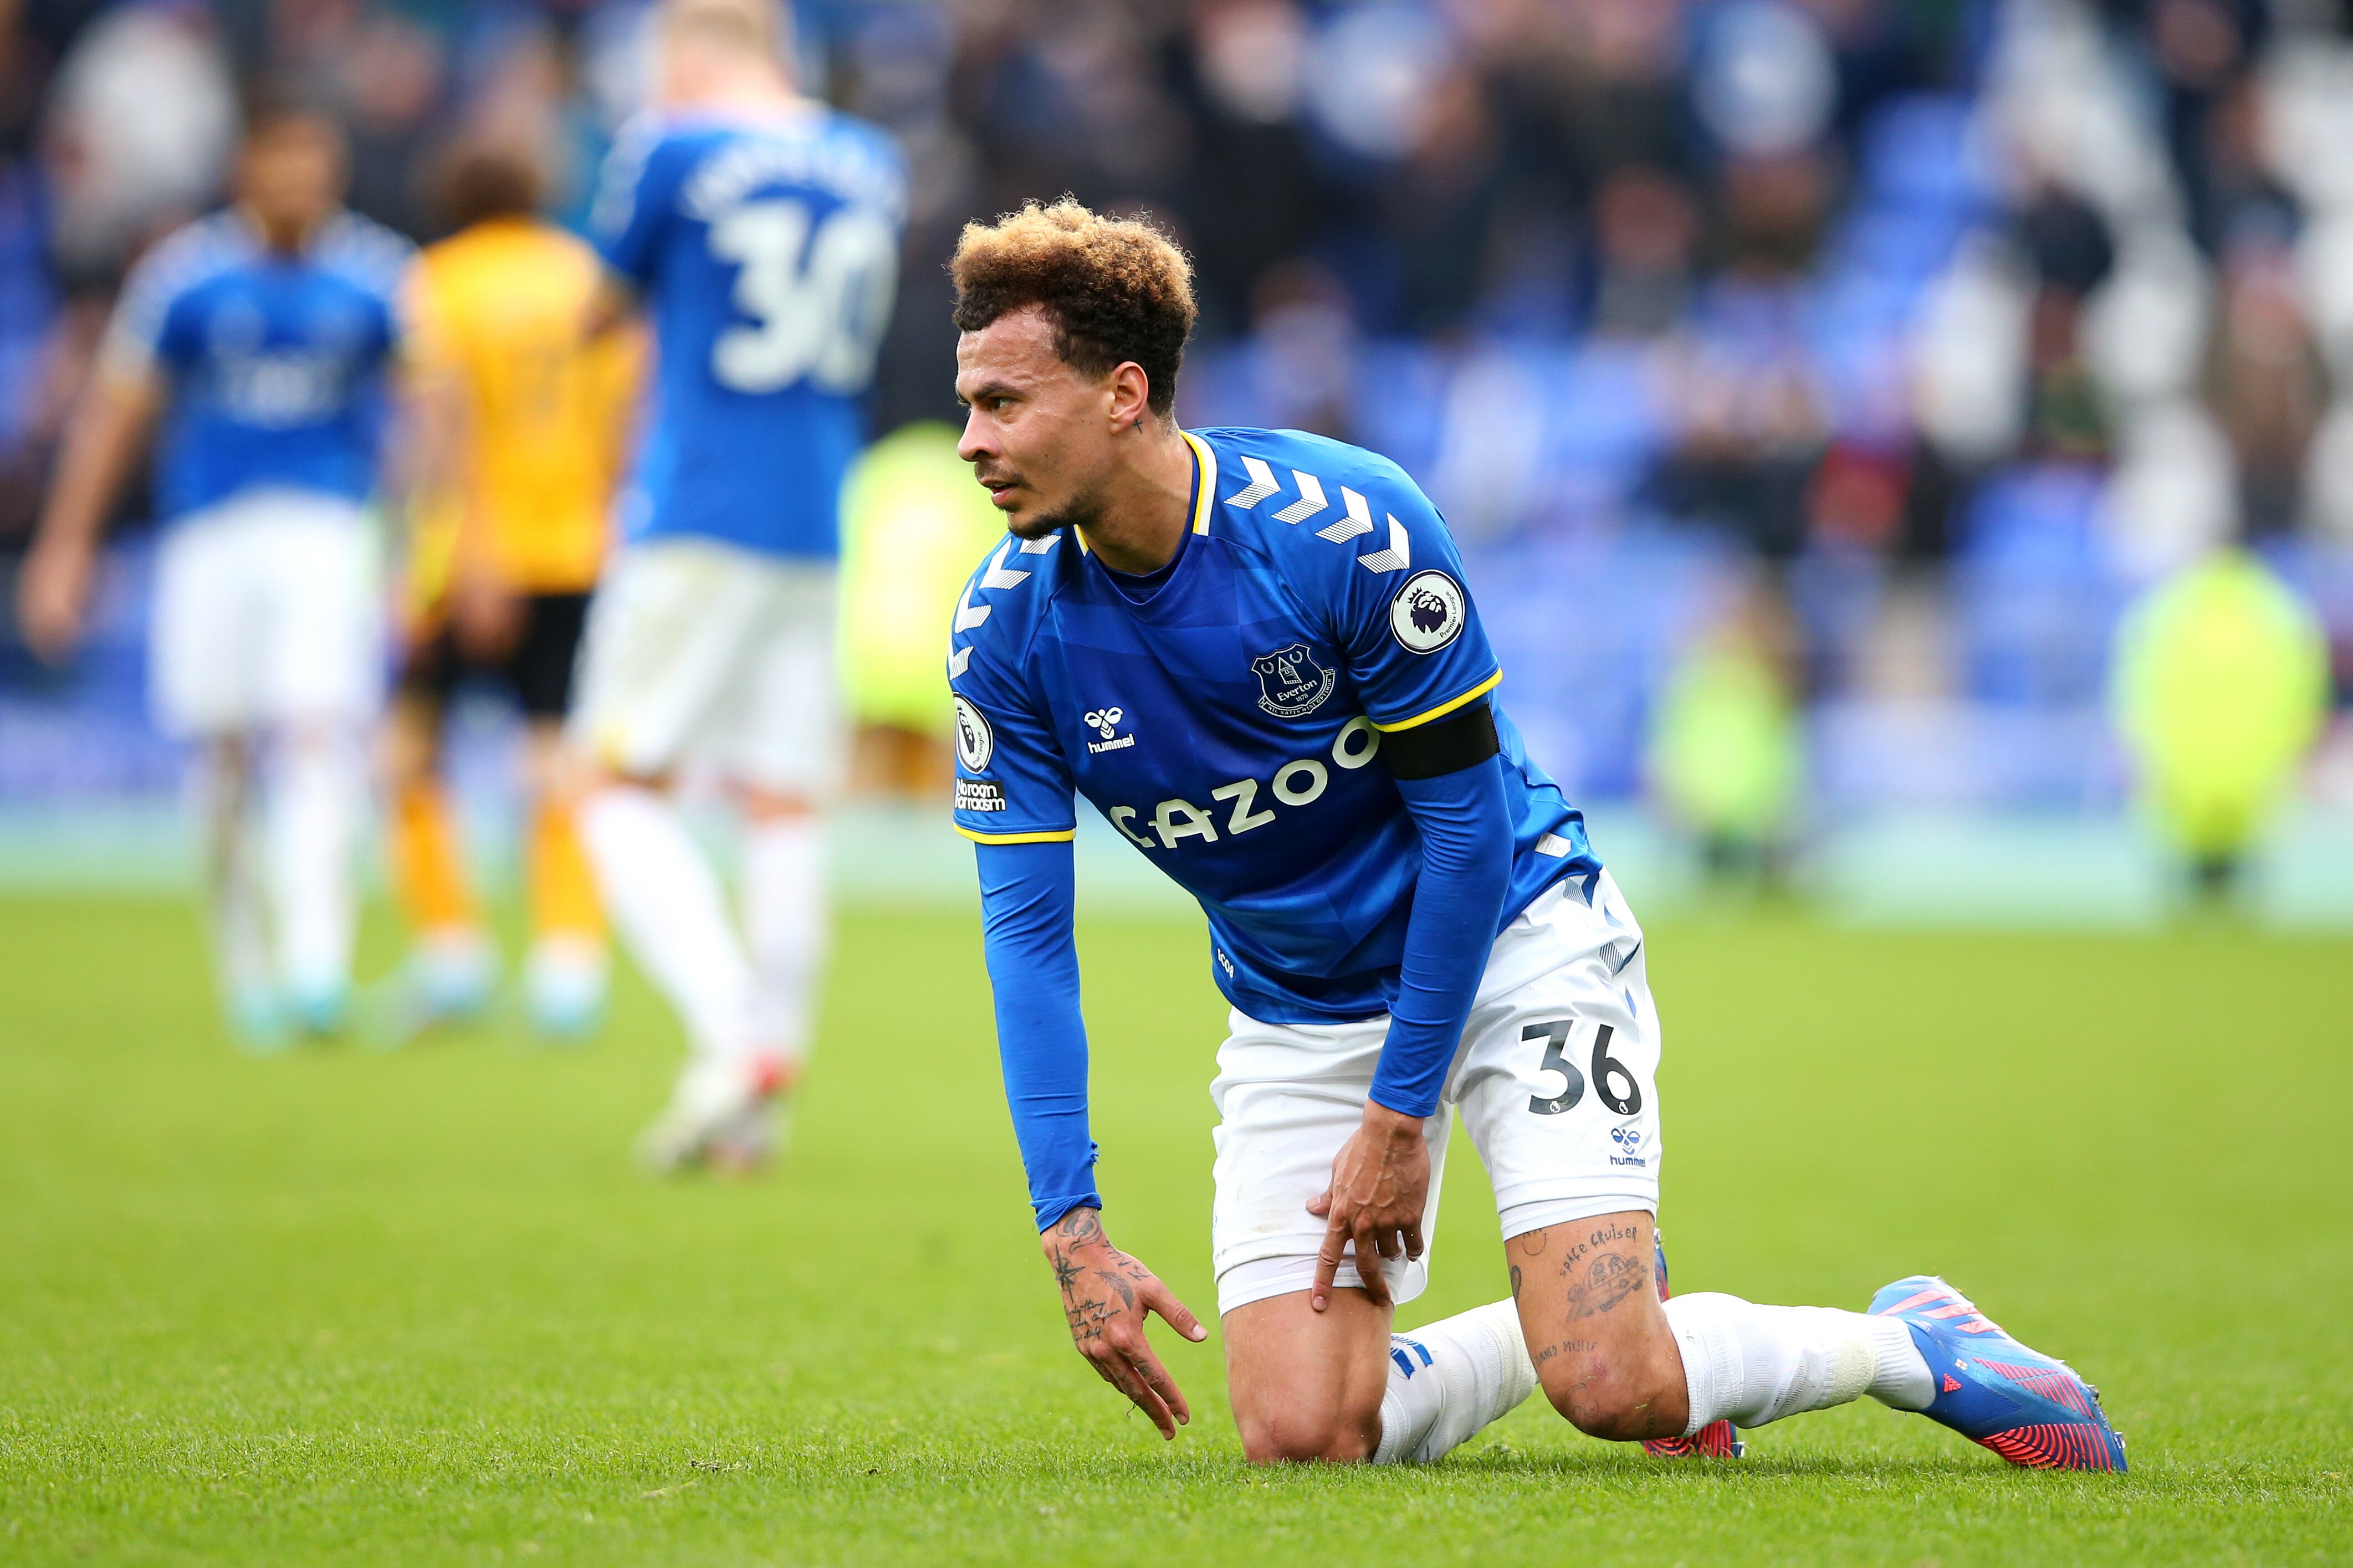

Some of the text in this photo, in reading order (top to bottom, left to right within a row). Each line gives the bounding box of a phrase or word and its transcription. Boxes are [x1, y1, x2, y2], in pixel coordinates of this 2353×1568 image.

[708, 198, 900, 396] 30
[1440, 591, 1457, 638] Premier League
[1277, 680, 1318, 701] Everton
[1295, 693, 1308, 702] 1878
[1302, 703, 1316, 712] NISI
[1316, 678, 1332, 704] OPTIMUM
[1088, 733, 1135, 754] hummel
[1110, 716, 1380, 848] CAZOO
[1521, 1019, 1642, 1115] 36
